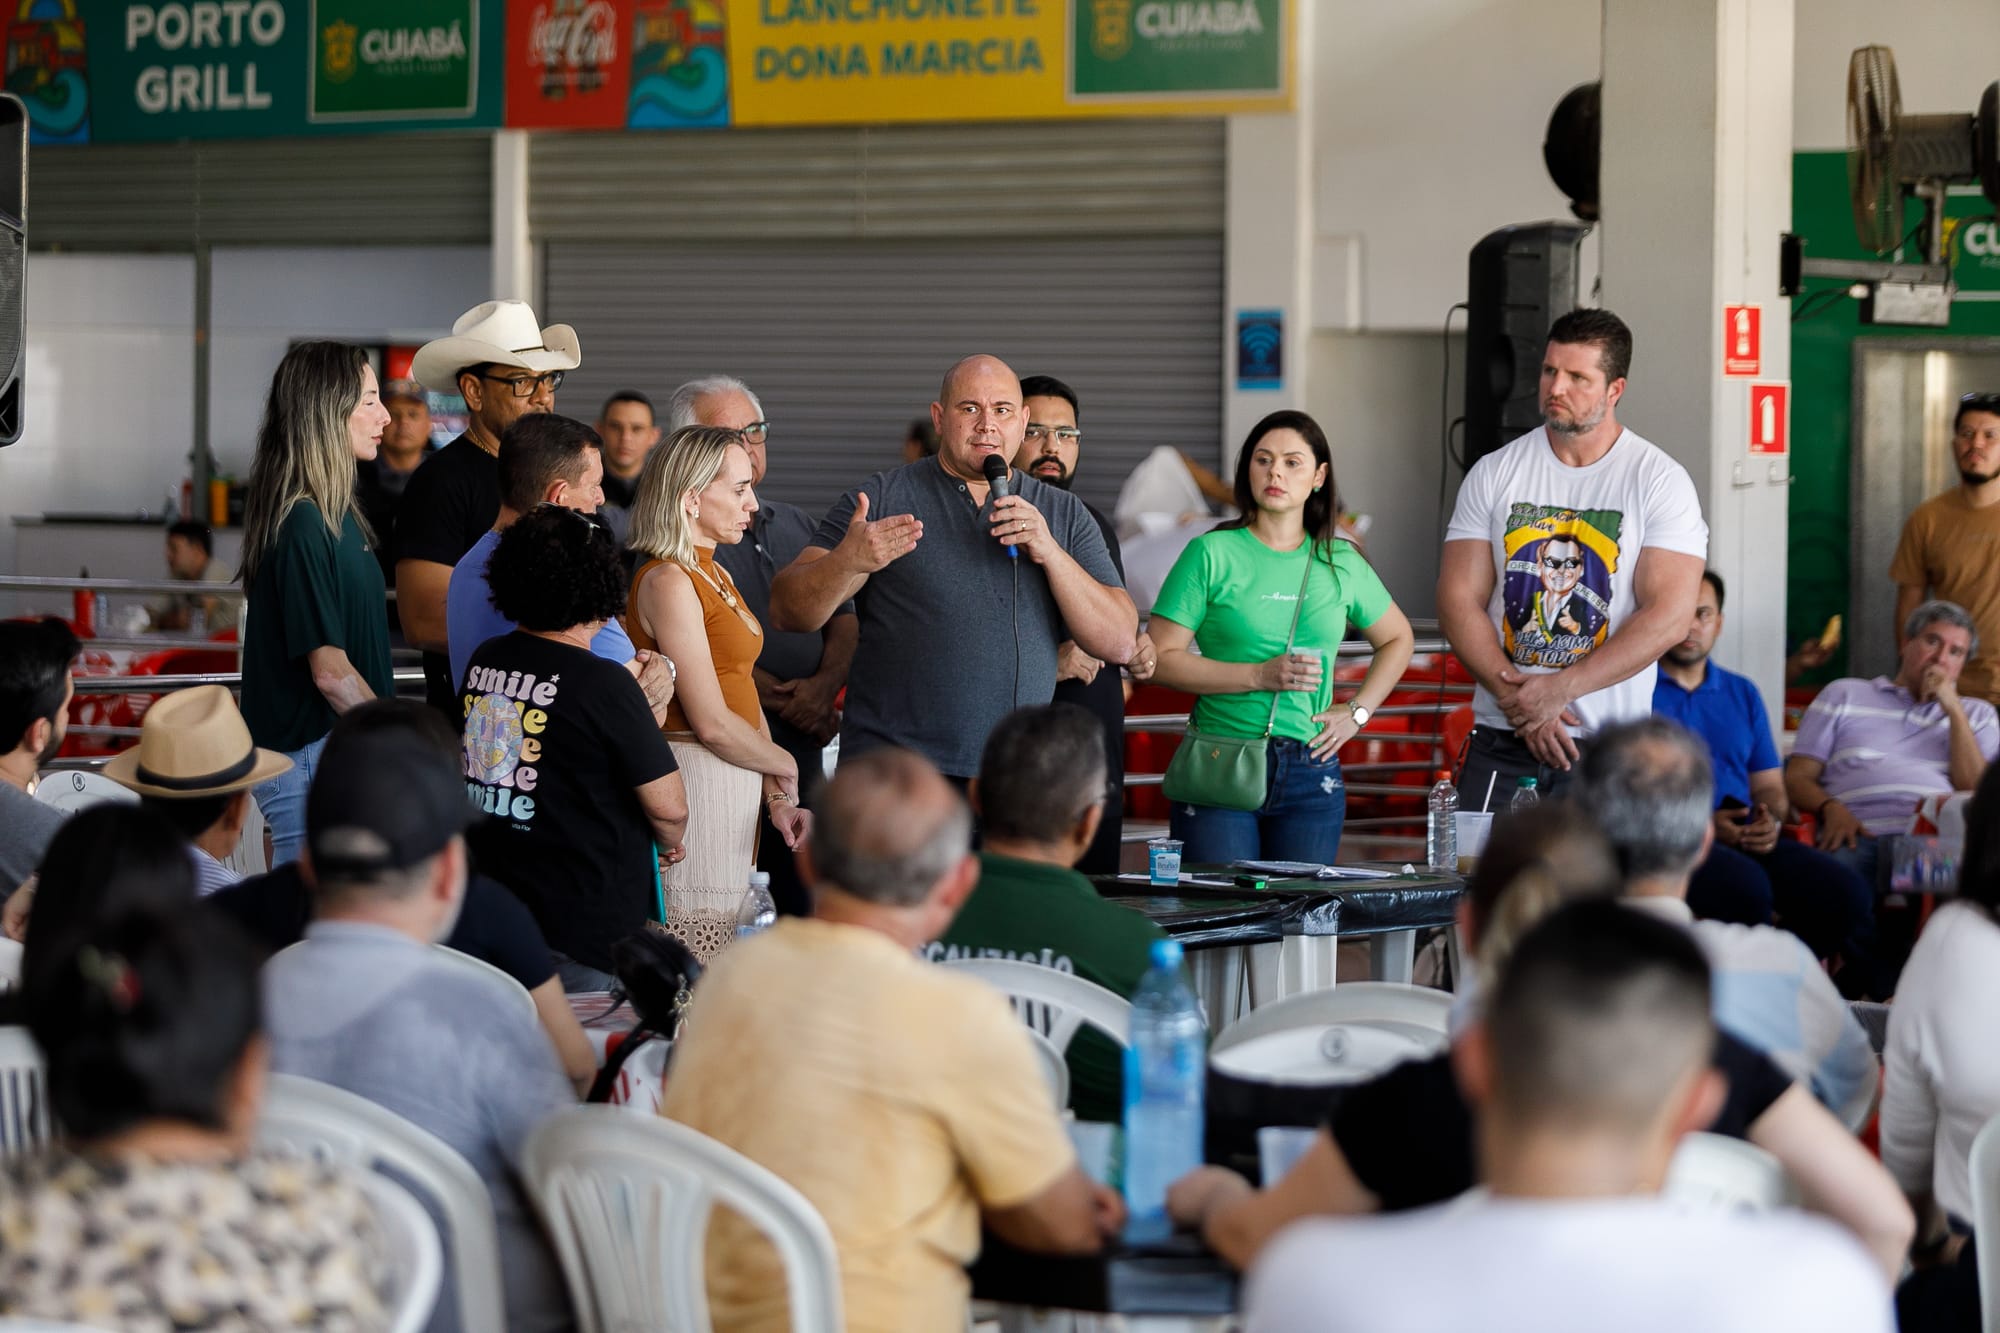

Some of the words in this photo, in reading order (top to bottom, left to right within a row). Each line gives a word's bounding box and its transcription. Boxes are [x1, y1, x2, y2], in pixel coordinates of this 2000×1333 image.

[126, 1, 285, 51] PORTO
[360, 19, 466, 63] CUIABÁ
[755, 44, 871, 82] DONA
[879, 37, 1044, 76] MARCIA
[135, 62, 273, 114] GRILL
[1513, 646, 1535, 662] DE
[1548, 634, 1597, 649] ACIMA
[467, 665, 558, 706] smile
